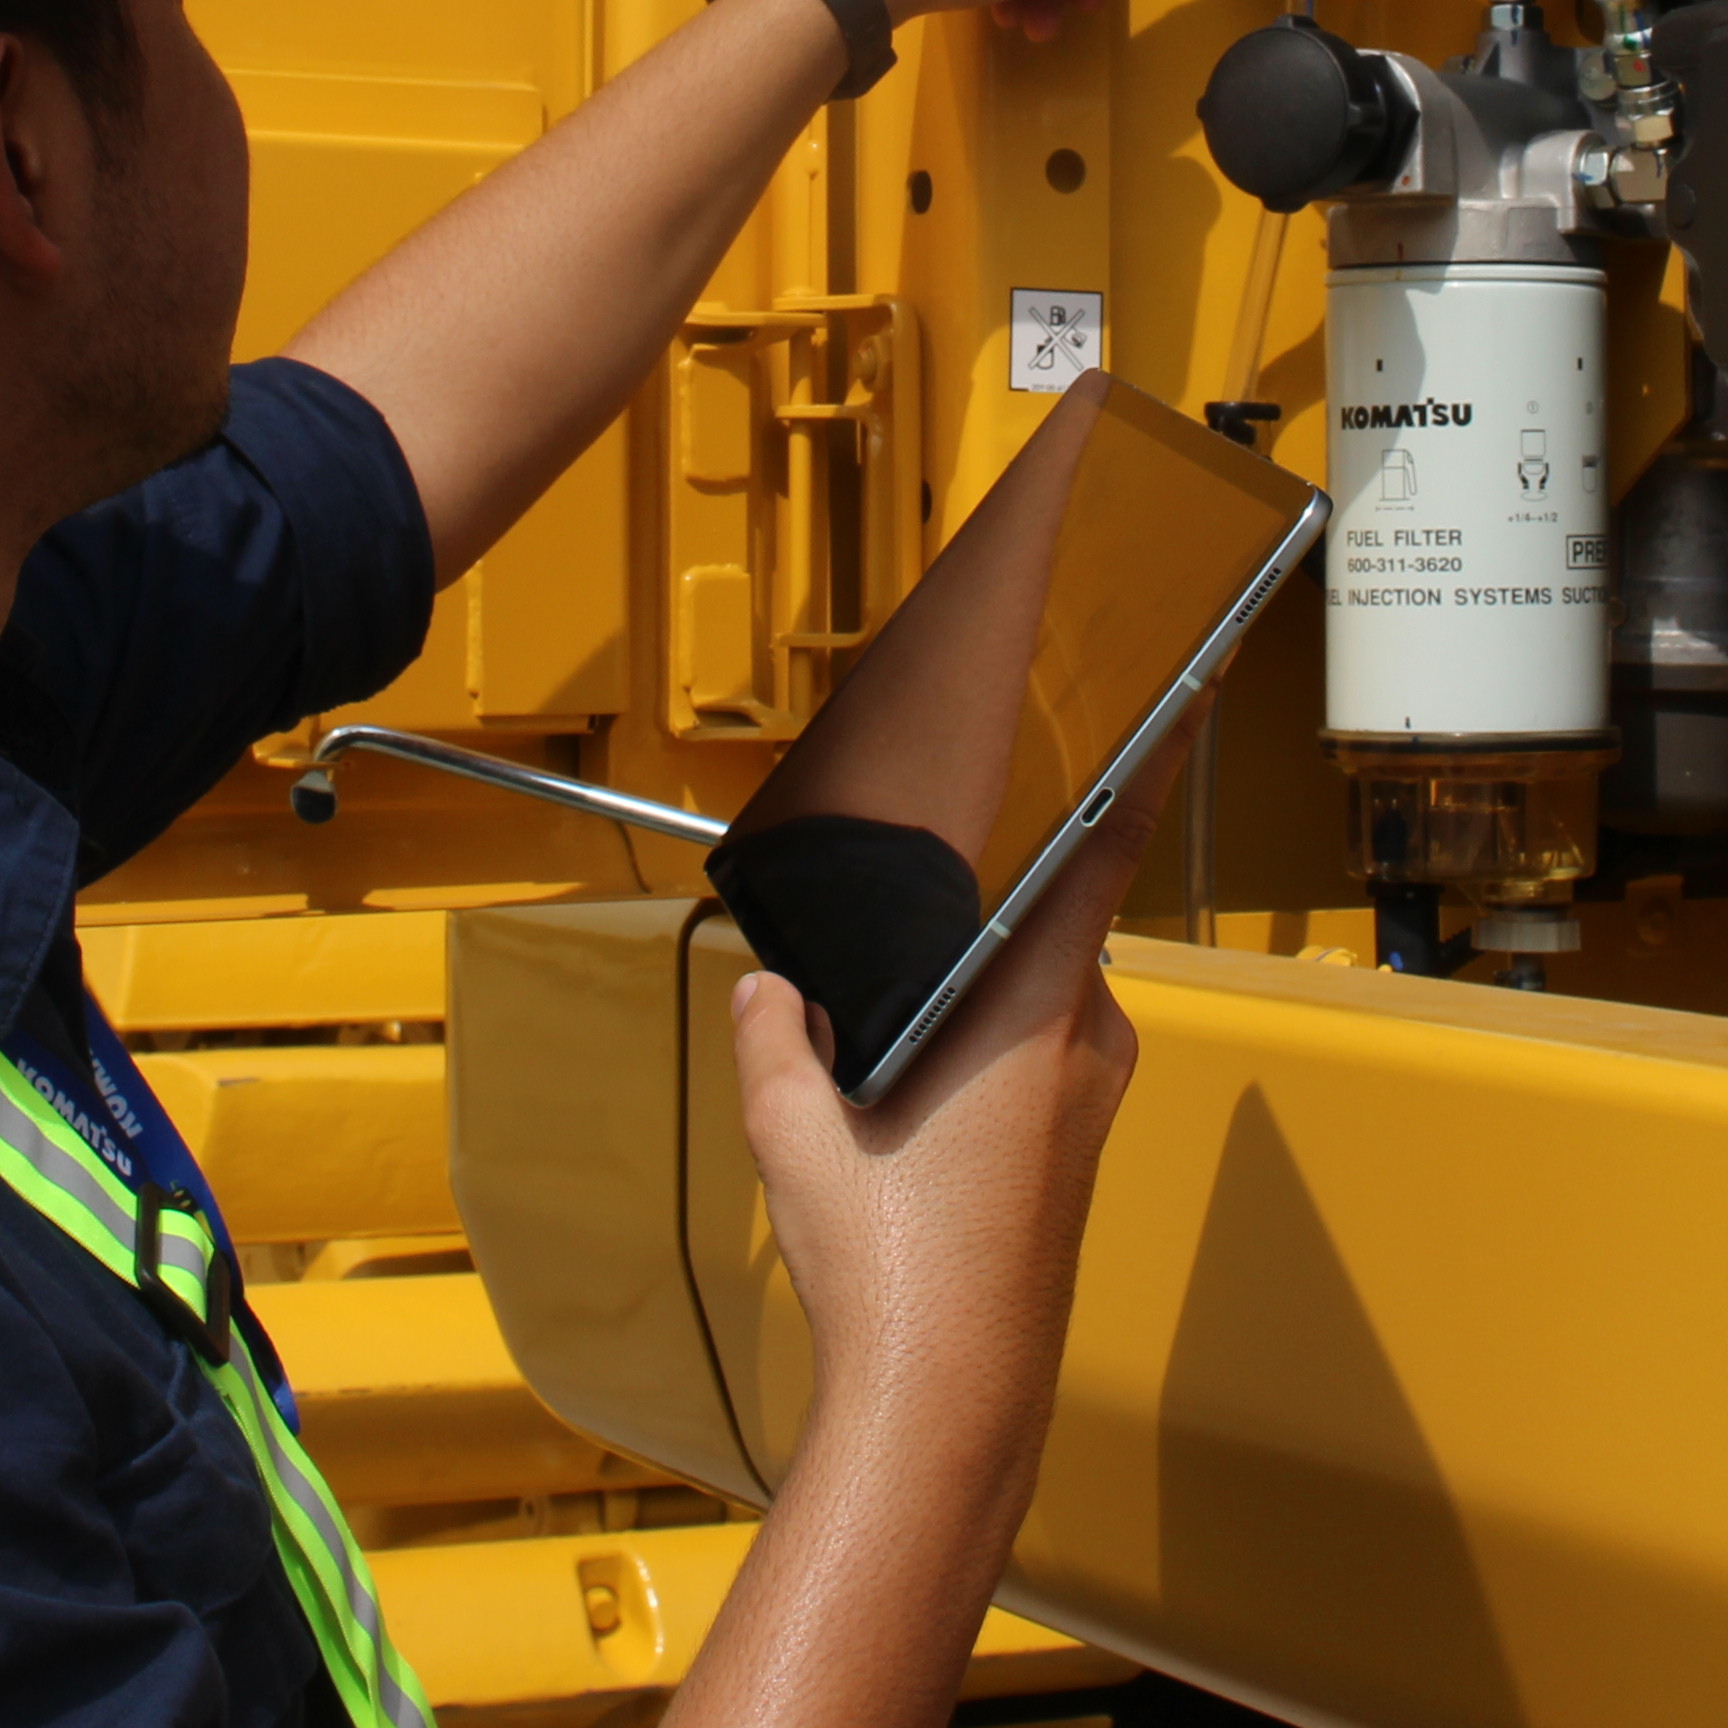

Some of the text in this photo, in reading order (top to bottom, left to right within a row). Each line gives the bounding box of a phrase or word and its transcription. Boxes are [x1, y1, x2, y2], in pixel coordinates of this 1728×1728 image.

[1341, 397, 1472, 430] KOMATSU
[1347, 528, 1463, 547] FUEL FILTER
[1348, 557, 1462, 574] 600-311-3620
[1348, 587, 1442, 606] INJECTION
[1454, 587, 1553, 606] SYSTEMS
